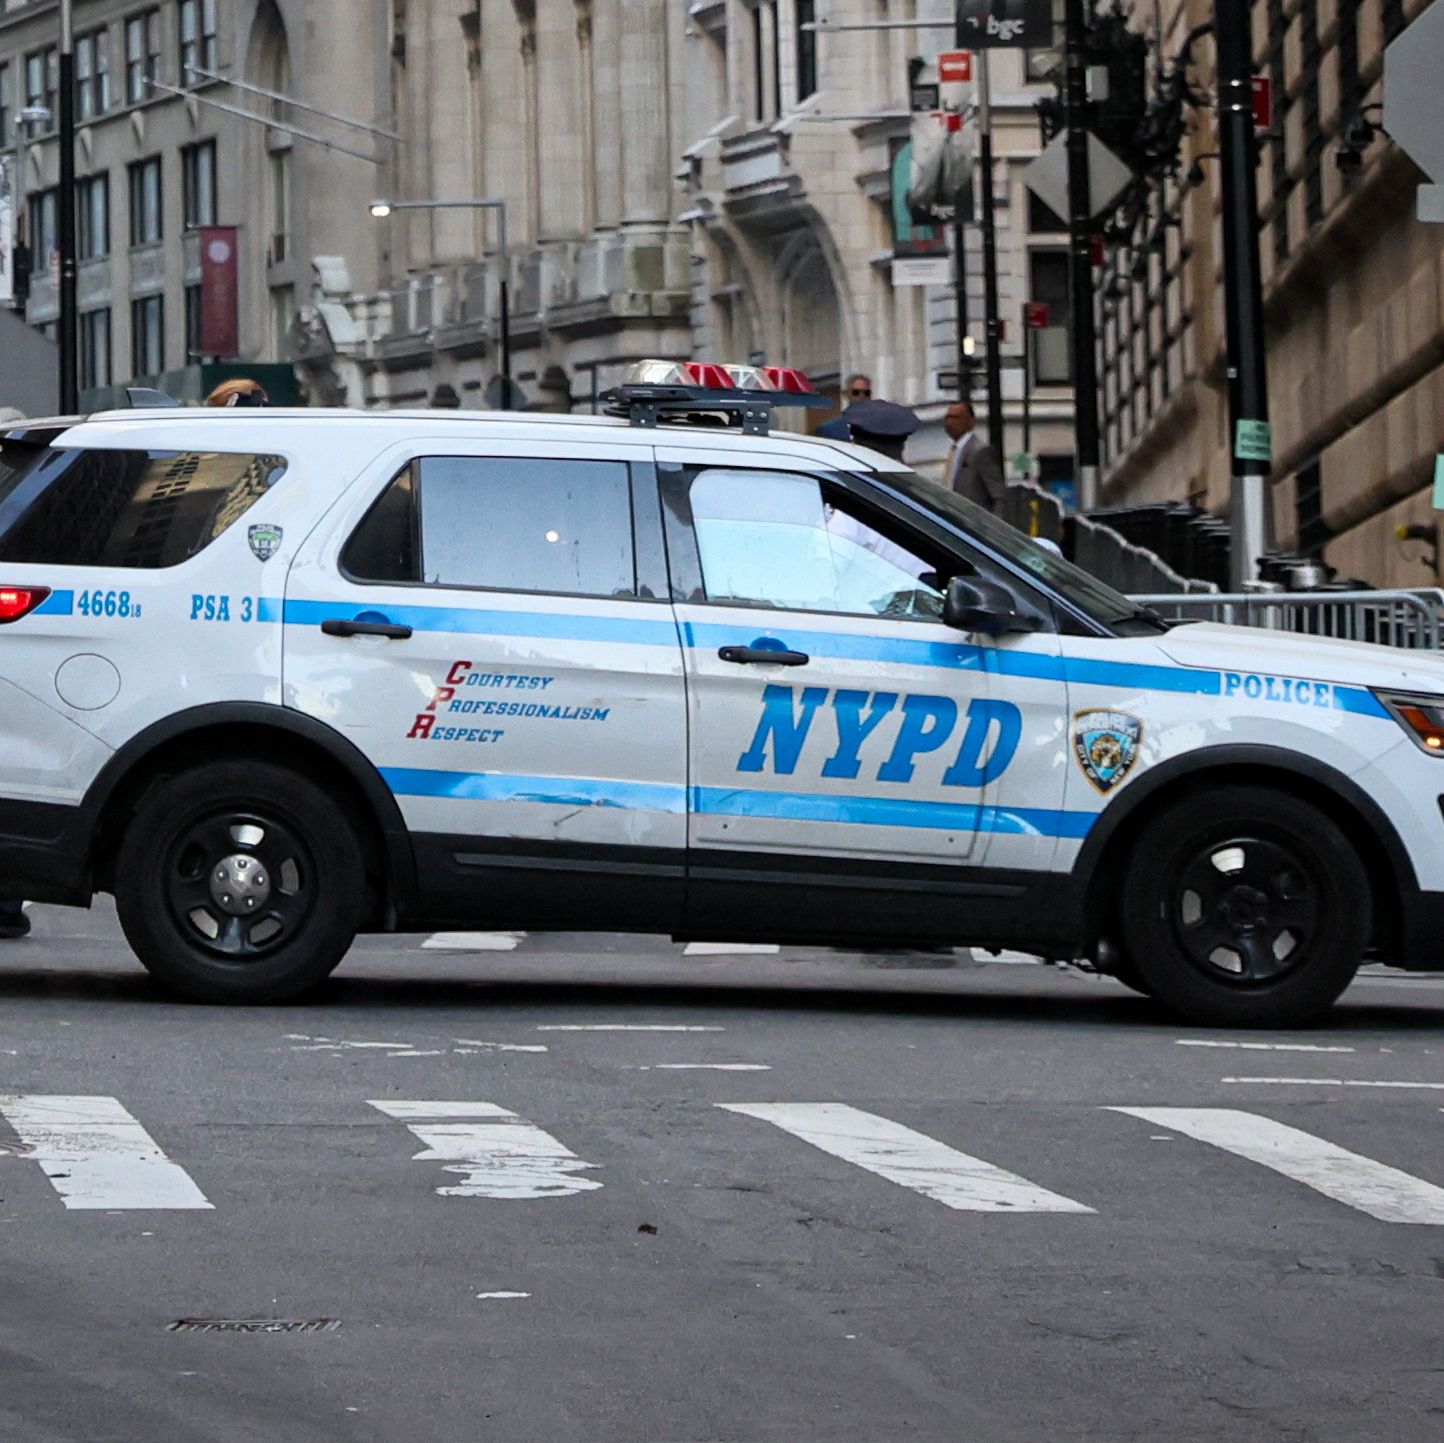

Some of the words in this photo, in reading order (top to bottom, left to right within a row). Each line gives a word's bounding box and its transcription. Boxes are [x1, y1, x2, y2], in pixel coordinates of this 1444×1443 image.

[986, 13, 1026, 40] bgc
[77, 589, 130, 617] 4668
[190, 594, 231, 621] PSA
[241, 596, 253, 623] 3
[445, 660, 554, 690] COURTESY
[1223, 671, 1334, 709] POLICE
[425, 686, 611, 722] PROFESSIONALISM
[406, 713, 505, 744] RESPECT
[737, 684, 1023, 788] NYPD
